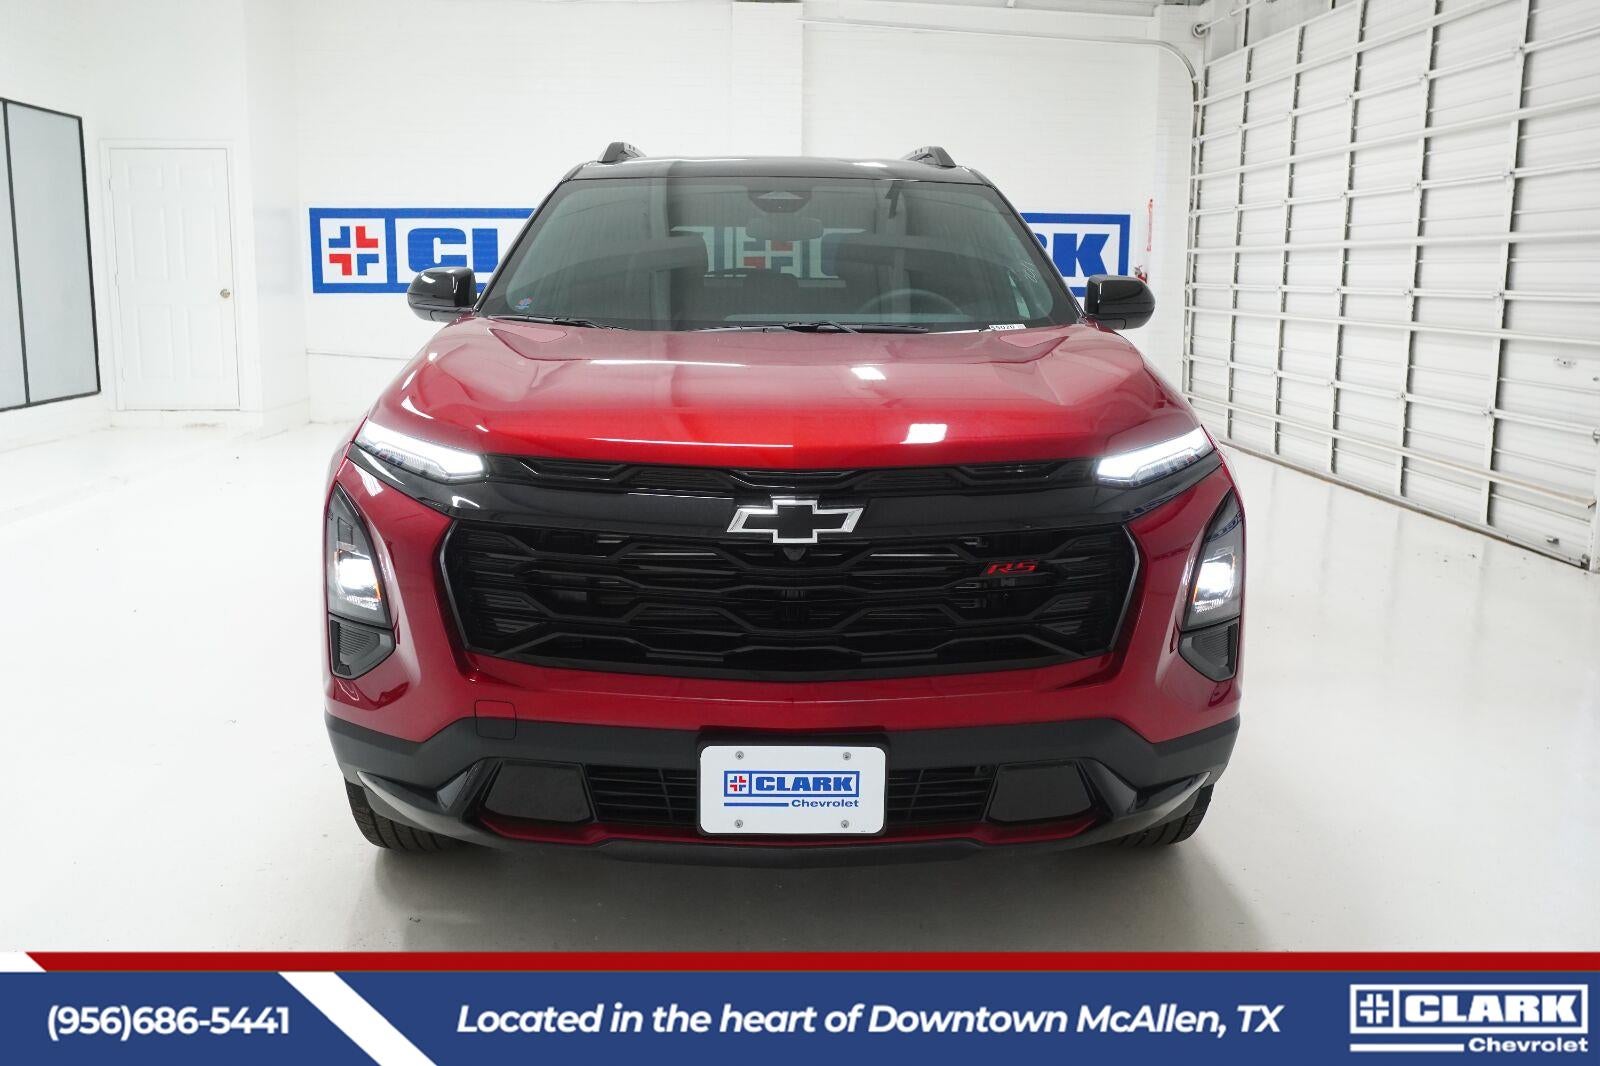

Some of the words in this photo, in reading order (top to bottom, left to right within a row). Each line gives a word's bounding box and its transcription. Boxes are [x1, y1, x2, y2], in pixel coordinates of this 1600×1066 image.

[986, 561, 1038, 575] RS
[755, 776, 853, 792] CLARK
[791, 799, 859, 808] Chevrolet
